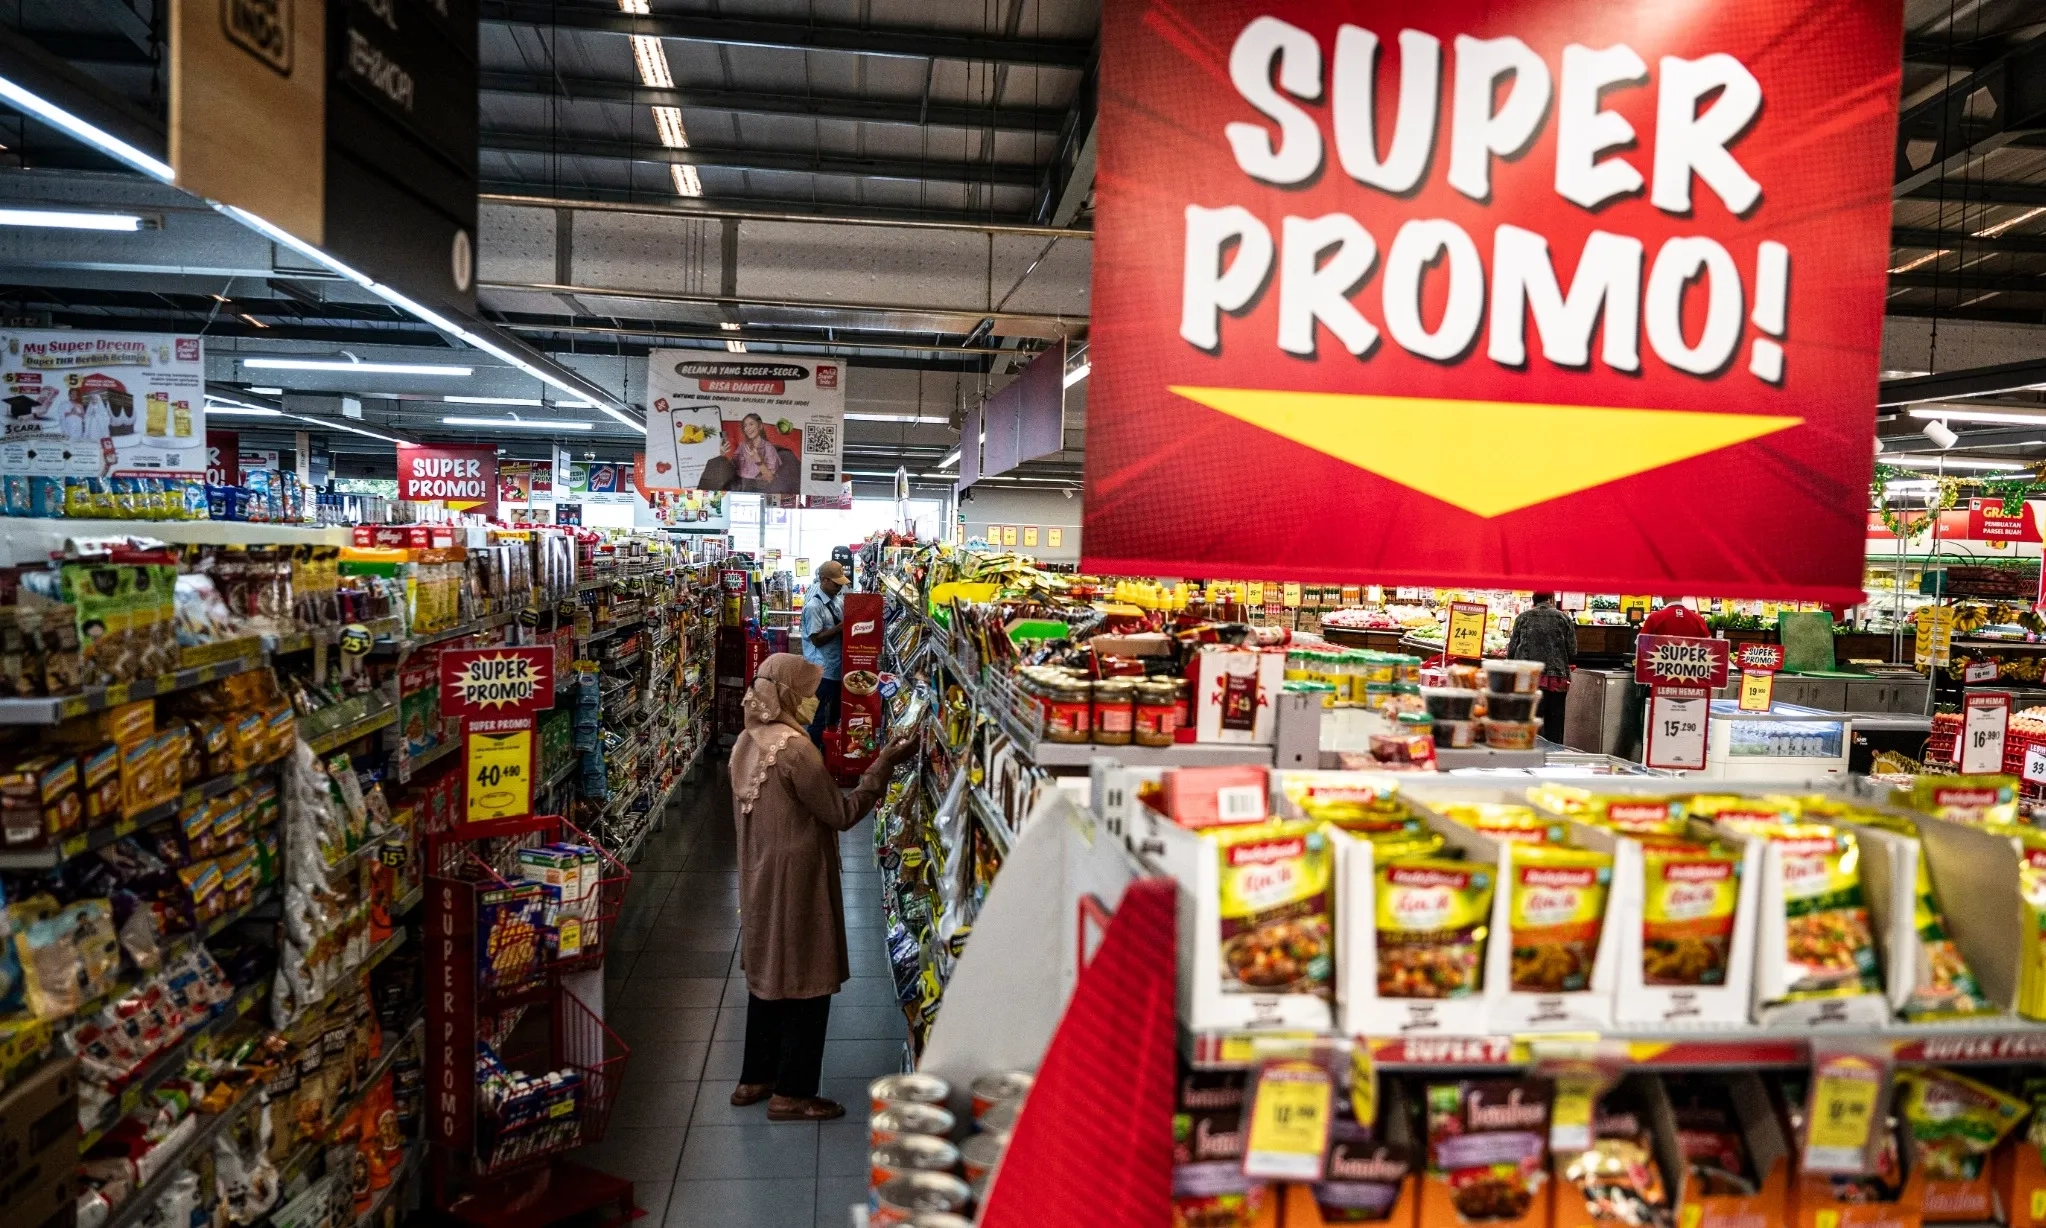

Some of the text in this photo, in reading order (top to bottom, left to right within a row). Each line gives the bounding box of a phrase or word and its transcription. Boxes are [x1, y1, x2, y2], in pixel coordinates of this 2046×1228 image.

[1226, 15, 1763, 216] SUPER
[1180, 203, 1791, 385] PROMO!
[24, 340, 145, 355] My Super Dream
[682, 366, 718, 376] BELANJA
[719, 366, 740, 376] YANG
[68, 374, 78, 386] 5
[709, 381, 730, 392] BISA
[14, 424, 41, 433] CARA
[412, 458, 481, 478] SUPER
[408, 480, 486, 498] PROMO!
[854, 622, 872, 633] Royco
[1660, 646, 1708, 663] SUPER
[1748, 648, 1774, 656] SUPER
[1745, 656, 1774, 665] PROMO!
[470, 659, 529, 682] SUPER
[1656, 662, 1711, 678] PROMO!
[466, 682, 534, 702] PROMO!
[1658, 686, 1705, 696] LEBIH HEMAT
[468, 718, 531, 731] SUPER PROMO!
[442, 887, 456, 1138] SUPER PROMO
